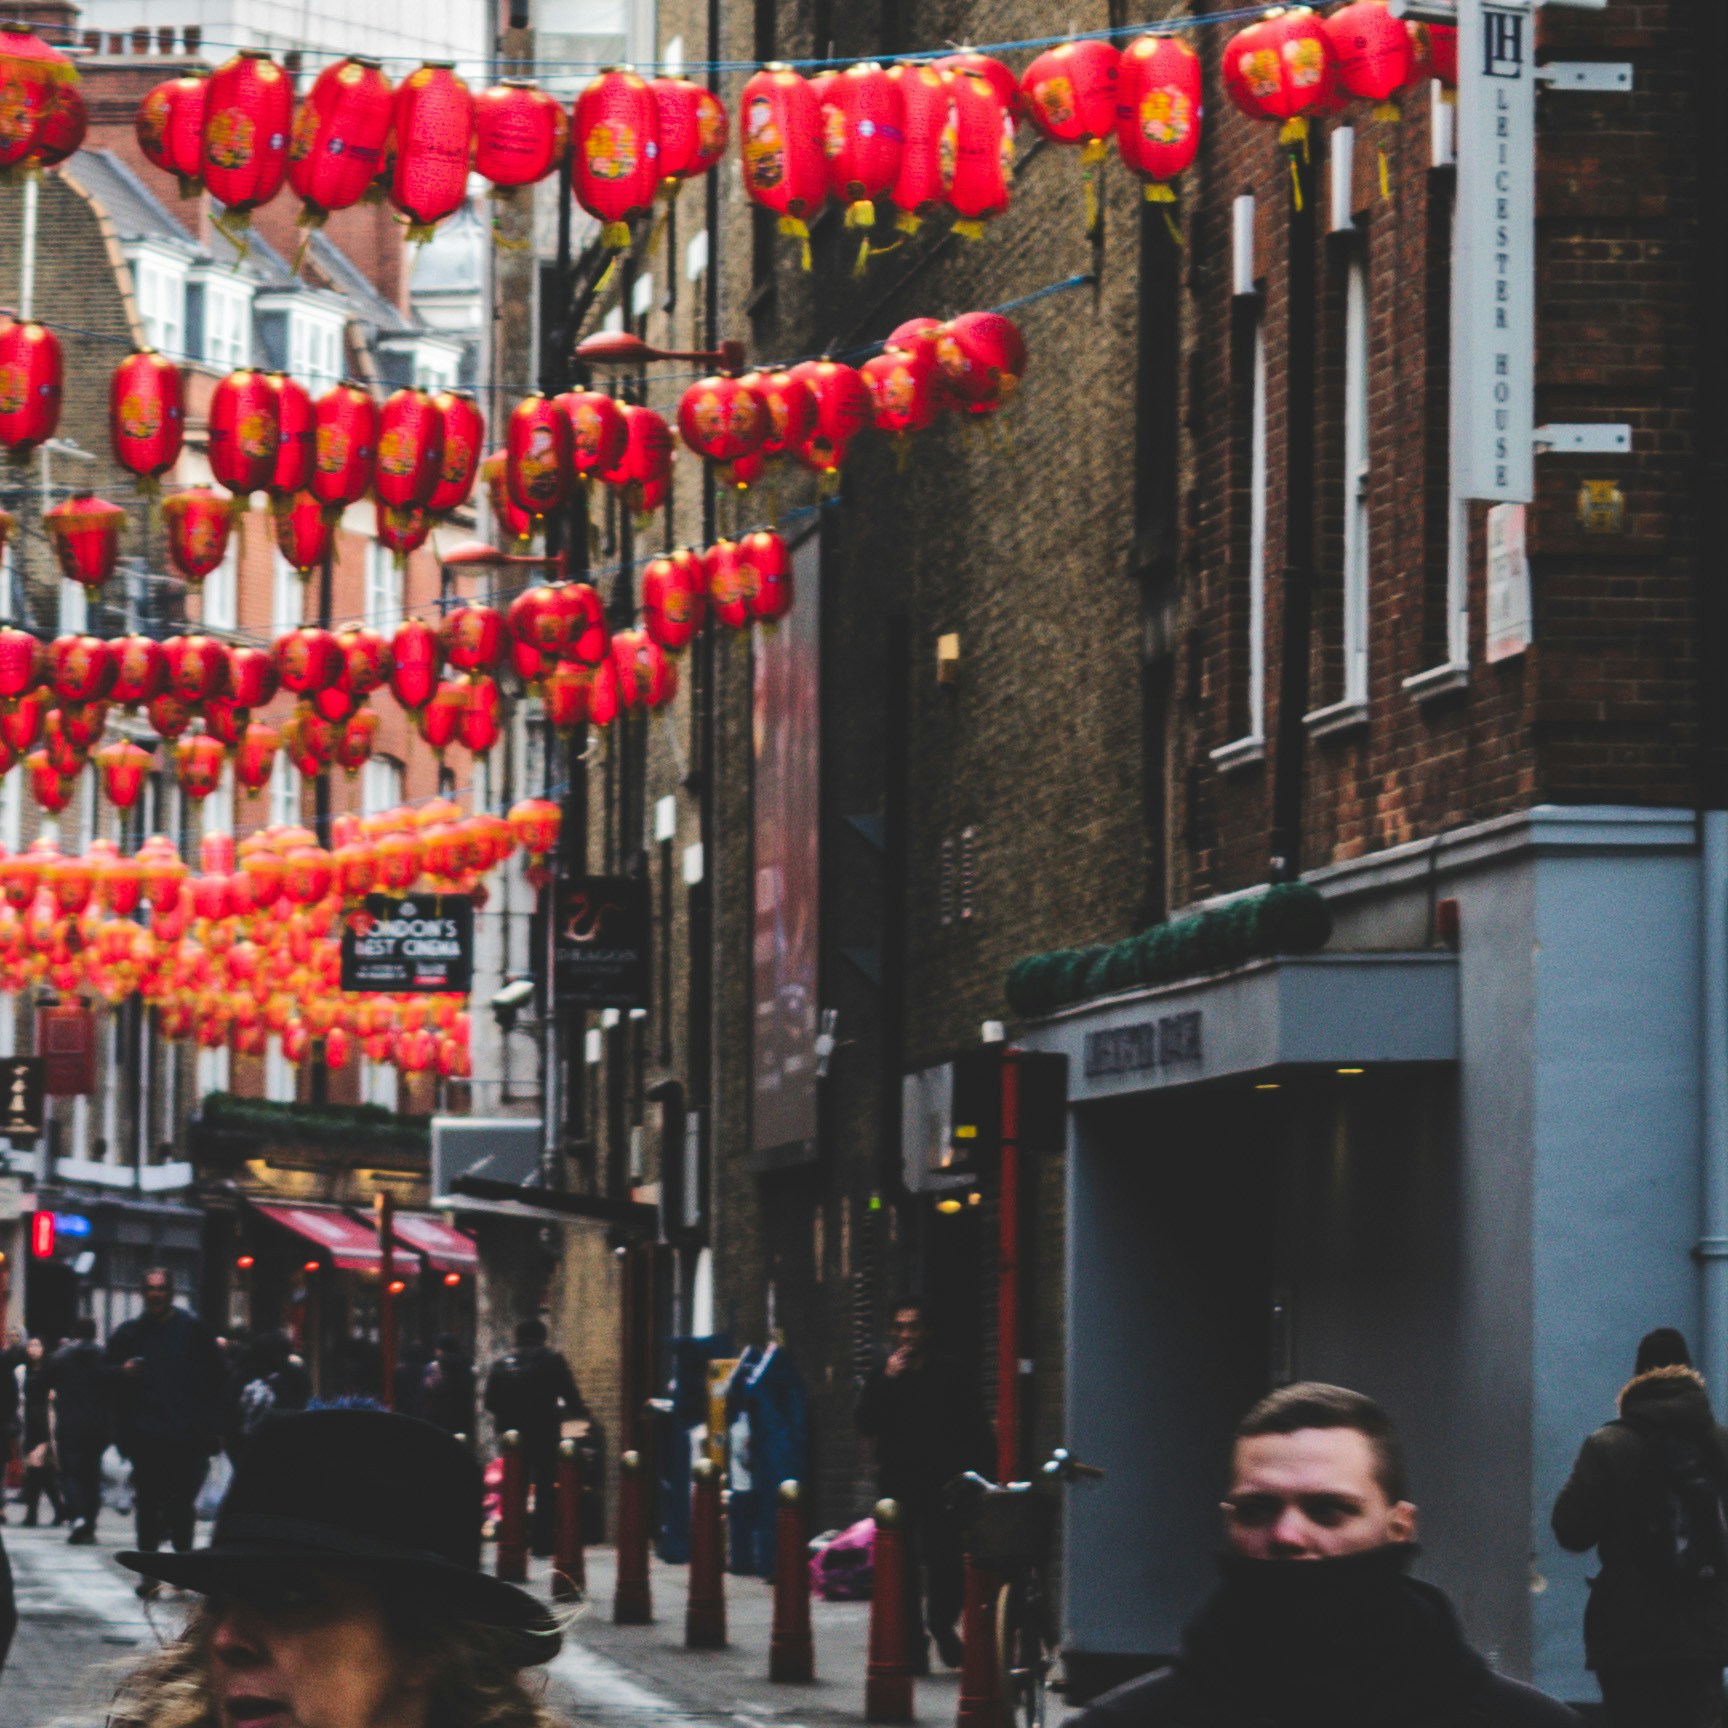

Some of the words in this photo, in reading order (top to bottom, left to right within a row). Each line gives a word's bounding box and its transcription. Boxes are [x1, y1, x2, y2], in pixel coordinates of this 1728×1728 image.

[1495, 88, 1510, 329] LEICESTER
[1494, 352, 1509, 487] HOUSE
[356, 918, 458, 938] ONDON'S
